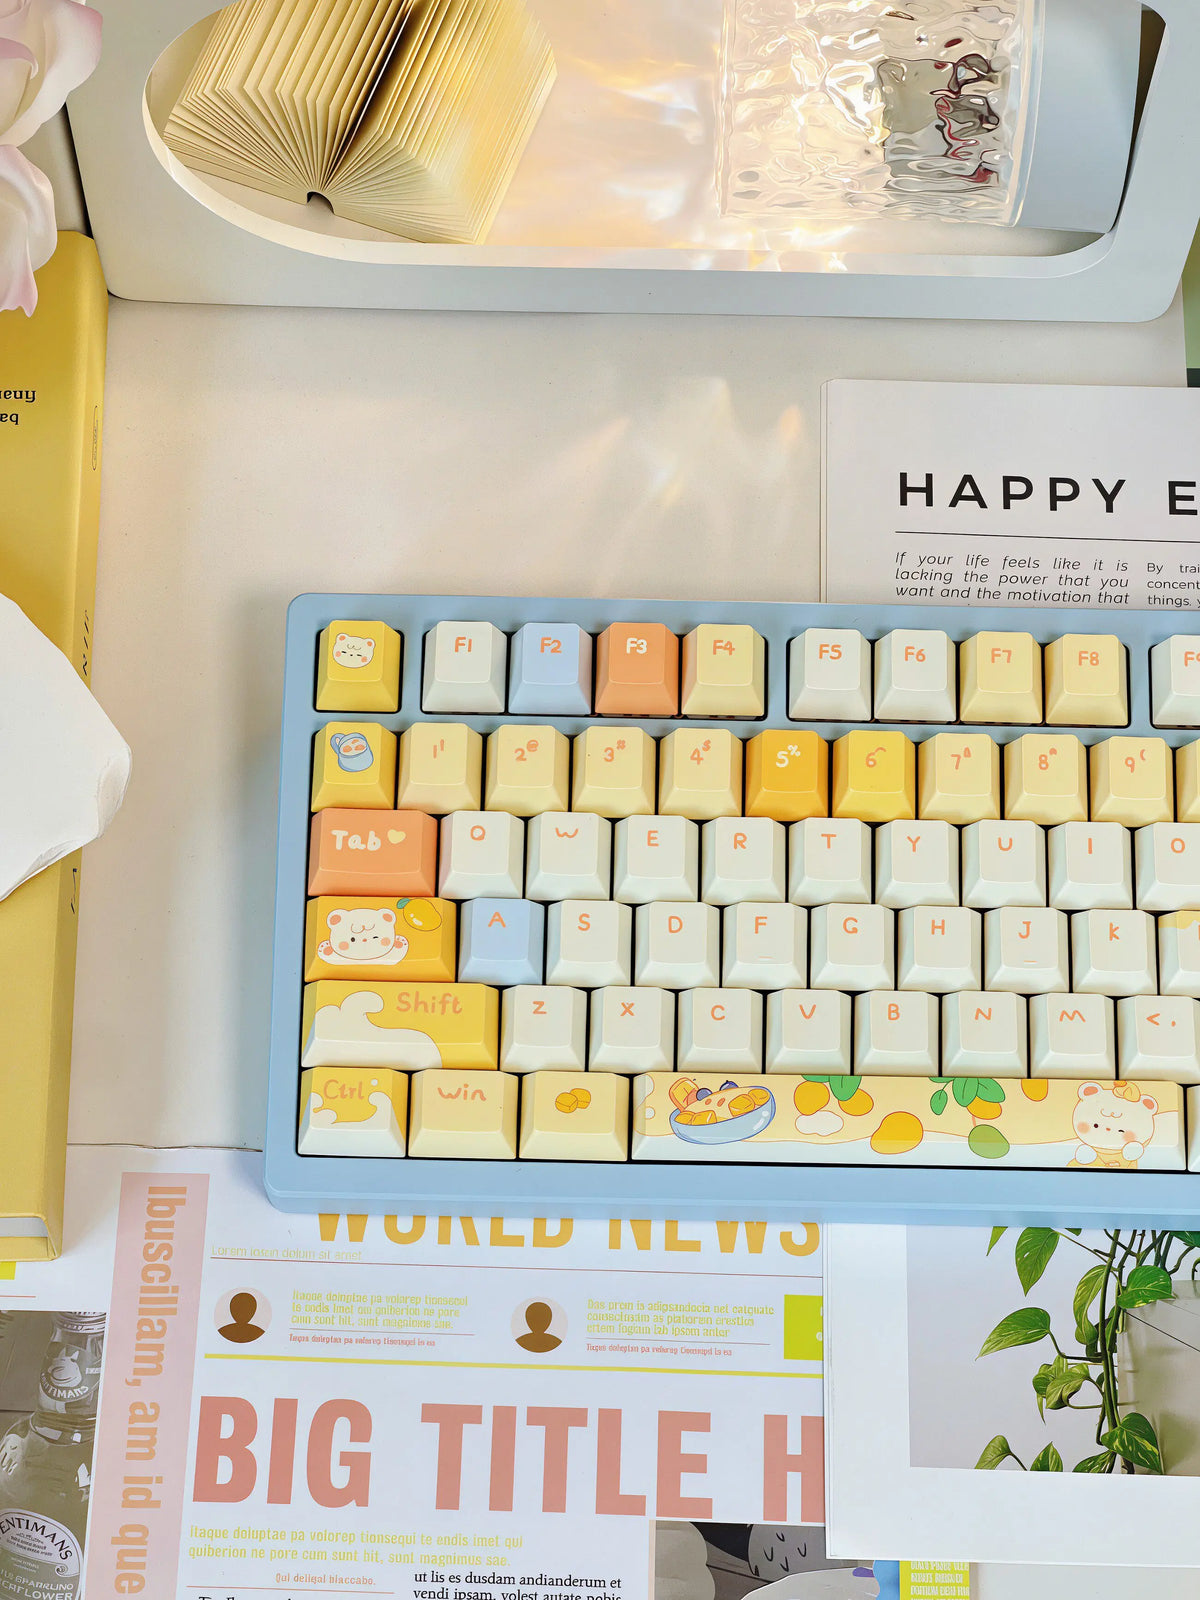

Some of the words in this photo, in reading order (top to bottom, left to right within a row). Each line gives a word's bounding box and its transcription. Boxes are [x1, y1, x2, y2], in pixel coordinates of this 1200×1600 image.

[899, 471, 1126, 514] HAPPY
[1168, 480, 1198, 515] E
[895, 552, 907, 566] If
[918, 555, 953, 567] your
[966, 554, 990, 568] life
[1002, 555, 1040, 570] feels
[1053, 557, 1081, 570] like
[1093, 558, 1103, 571] it
[1116, 559, 1128, 571] is
[1147, 562, 1164, 575] By
[1179, 564, 1200, 574] trai
[895, 568, 953, 584] lacking
[964, 571, 989, 583] the
[998, 573, 1048, 587] power
[1058, 574, 1090, 587] that
[1100, 577, 1129, 590] you
[896, 586, 935, 597] want
[940, 587, 971, 599] and
[977, 587, 1002, 600] the
[1007, 589, 1091, 603] motivation
[1098, 591, 1130, 604] that
[454, 636, 473, 653] F1
[539, 636, 563, 654] F2
[625, 637, 648, 655] F3
[712, 639, 736, 656] F4
[818, 643, 843, 661] F5
[904, 645, 926, 663] F6
[990, 647, 1013, 665] F7
[1077, 650, 1100, 667] F8
[332, 829, 382, 852] Tab
[647, 830, 660, 847] E
[733, 832, 748, 850] R
[820, 833, 837, 849] T
[906, 835, 922, 853] Y
[997, 837, 1014, 852] U
[1170, 837, 1187, 854] O
[488, 911, 507, 929] A
[577, 913, 592, 932] S
[667, 915, 684, 934] D
[754, 916, 768, 935] F
[842, 916, 859, 935] G
[930, 918, 947, 936] H
[1017, 920, 1032, 940] J
[396, 991, 463, 1016] Shift
[710, 1004, 727, 1021] C
[799, 1004, 817, 1021] V
[887, 1003, 901, 1021] B
[974, 1007, 993, 1022] N
[323, 1078, 365, 1100] Ctrl
[212, 1245, 247, 1257] Lorem
[125, 1401, 161, 1461] am
[192, 1395, 373, 1508] BIG
[421, 1402, 714, 1520] TITLE
[763, 1413, 826, 1522] H
[121, 1475, 163, 1509] id
[190, 1525, 229, 1542] Itaque
[233, 1526, 287, 1543] doluptae
[290, 1530, 305, 1543] pa
[310, 1529, 356, 1545] volorep
[361, 1531, 417, 1548] tionsequi
[420, 1534, 433, 1546] te
[436, 1533, 469, 1547] endis
[473, 1534, 500, 1548] imet
[504, 1535, 523, 1549] qui
[111, 1523, 150, 1595] que
[188, 1544, 247, 1560] quiberion
[251, 1548, 265, 1559] ne
[270, 1549, 298, 1562] pore
[302, 1550, 327, 1561] cum
[331, 1550, 358, 1562] sunt
[363, 1550, 384, 1565] hit,
[388, 1551, 414, 1565] sunt
[419, 1552, 482, 1568] magnimus
[486, 1555, 512, 1567] sae.
[414, 1572, 426, 1583] ut
[431, 1570, 445, 1583] lis
[449, 1574, 461, 1584] es
[464, 1571, 515, 1586] dusdam
[519, 1573, 607, 1588] andianderum
[610, 1578, 622, 1589] et
[413, 1586, 450, 1600] vendi
